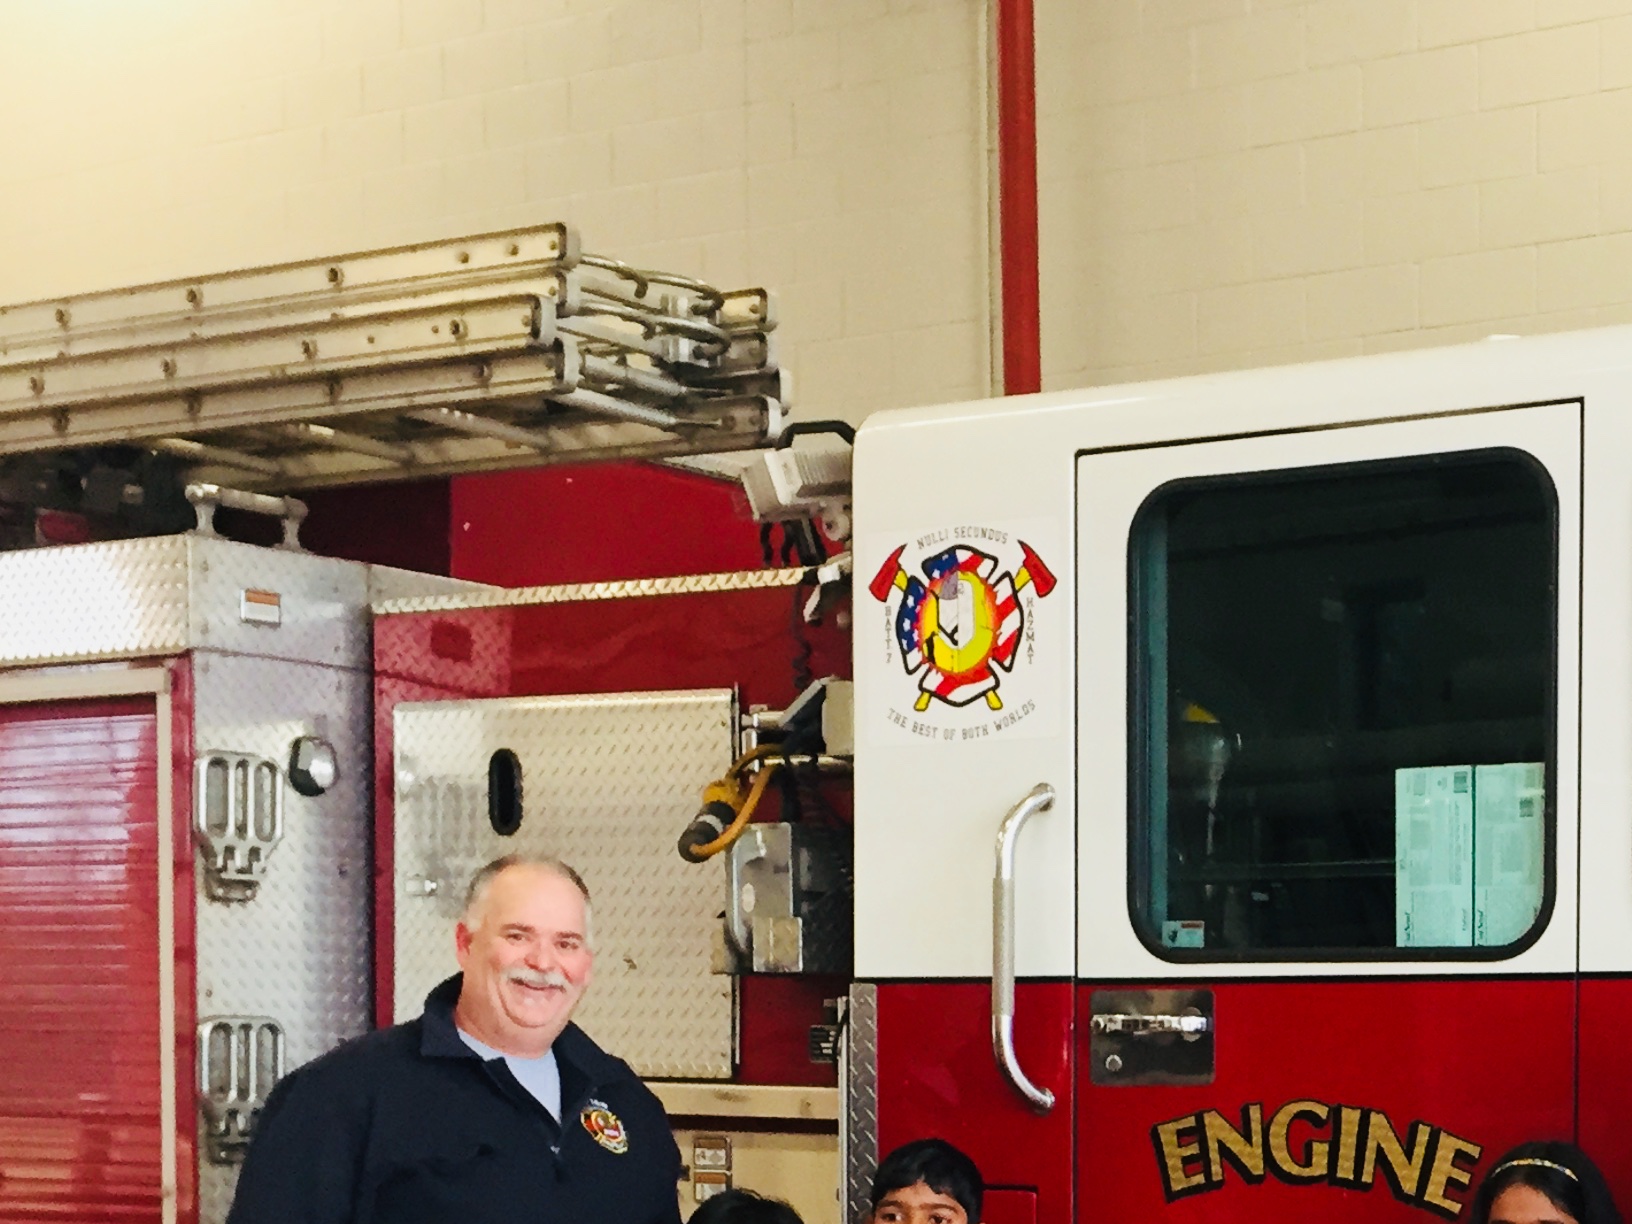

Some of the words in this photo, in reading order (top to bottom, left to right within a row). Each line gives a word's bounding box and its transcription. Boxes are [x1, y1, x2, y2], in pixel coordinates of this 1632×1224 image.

[916, 528, 949, 550] NULLI
[954, 525, 1009, 545] SECUNDUS
[1025, 597, 1036, 664] HAZMAT
[888, 708, 907, 729] THE
[911, 724, 938, 740] BEST
[943, 726, 956, 740] OF
[961, 726, 989, 741] BOTH
[993, 699, 1036, 732] WORLDS
[1152, 1099, 1482, 1220] ENGINE
